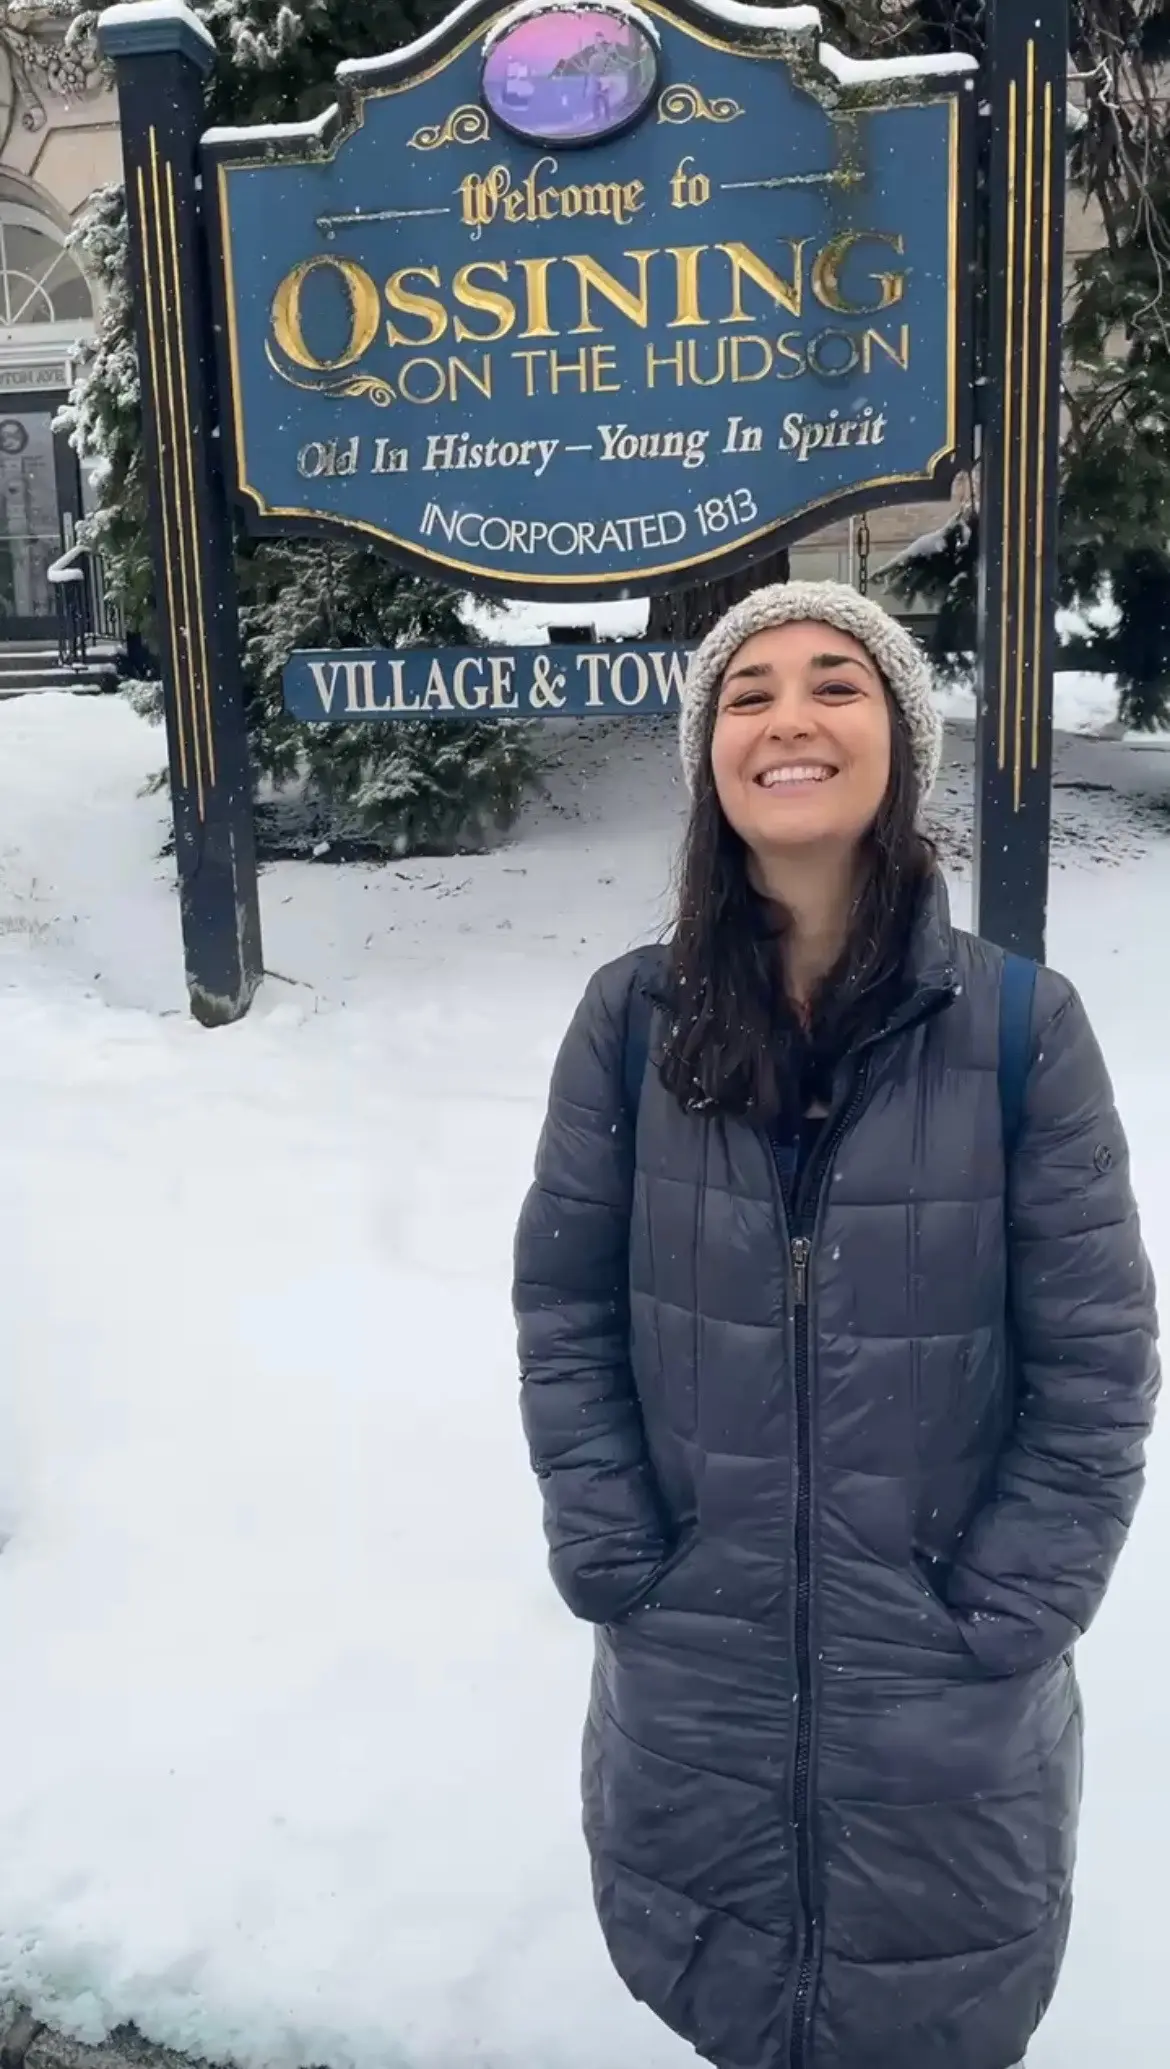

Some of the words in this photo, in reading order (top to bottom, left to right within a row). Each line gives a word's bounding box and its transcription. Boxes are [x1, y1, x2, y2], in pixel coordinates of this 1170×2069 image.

[452, 156, 646, 241] Welcome
[669, 156, 711, 209] to
[265, 229, 905, 373] OSSINING
[398, 353, 493, 404] ON
[511, 344, 621, 397] THE
[646, 323, 909, 388] HUDSON
[296, 436, 360, 479] Old
[370, 438, 408, 474] In
[722, 416, 763, 453] In
[778, 406, 887, 462] Spirit
[419, 501, 686, 556] INCORPORATED
[693, 487, 758, 536] 1813
[307, 656, 520, 714] VILLAGE
[528, 655, 566, 709] &
